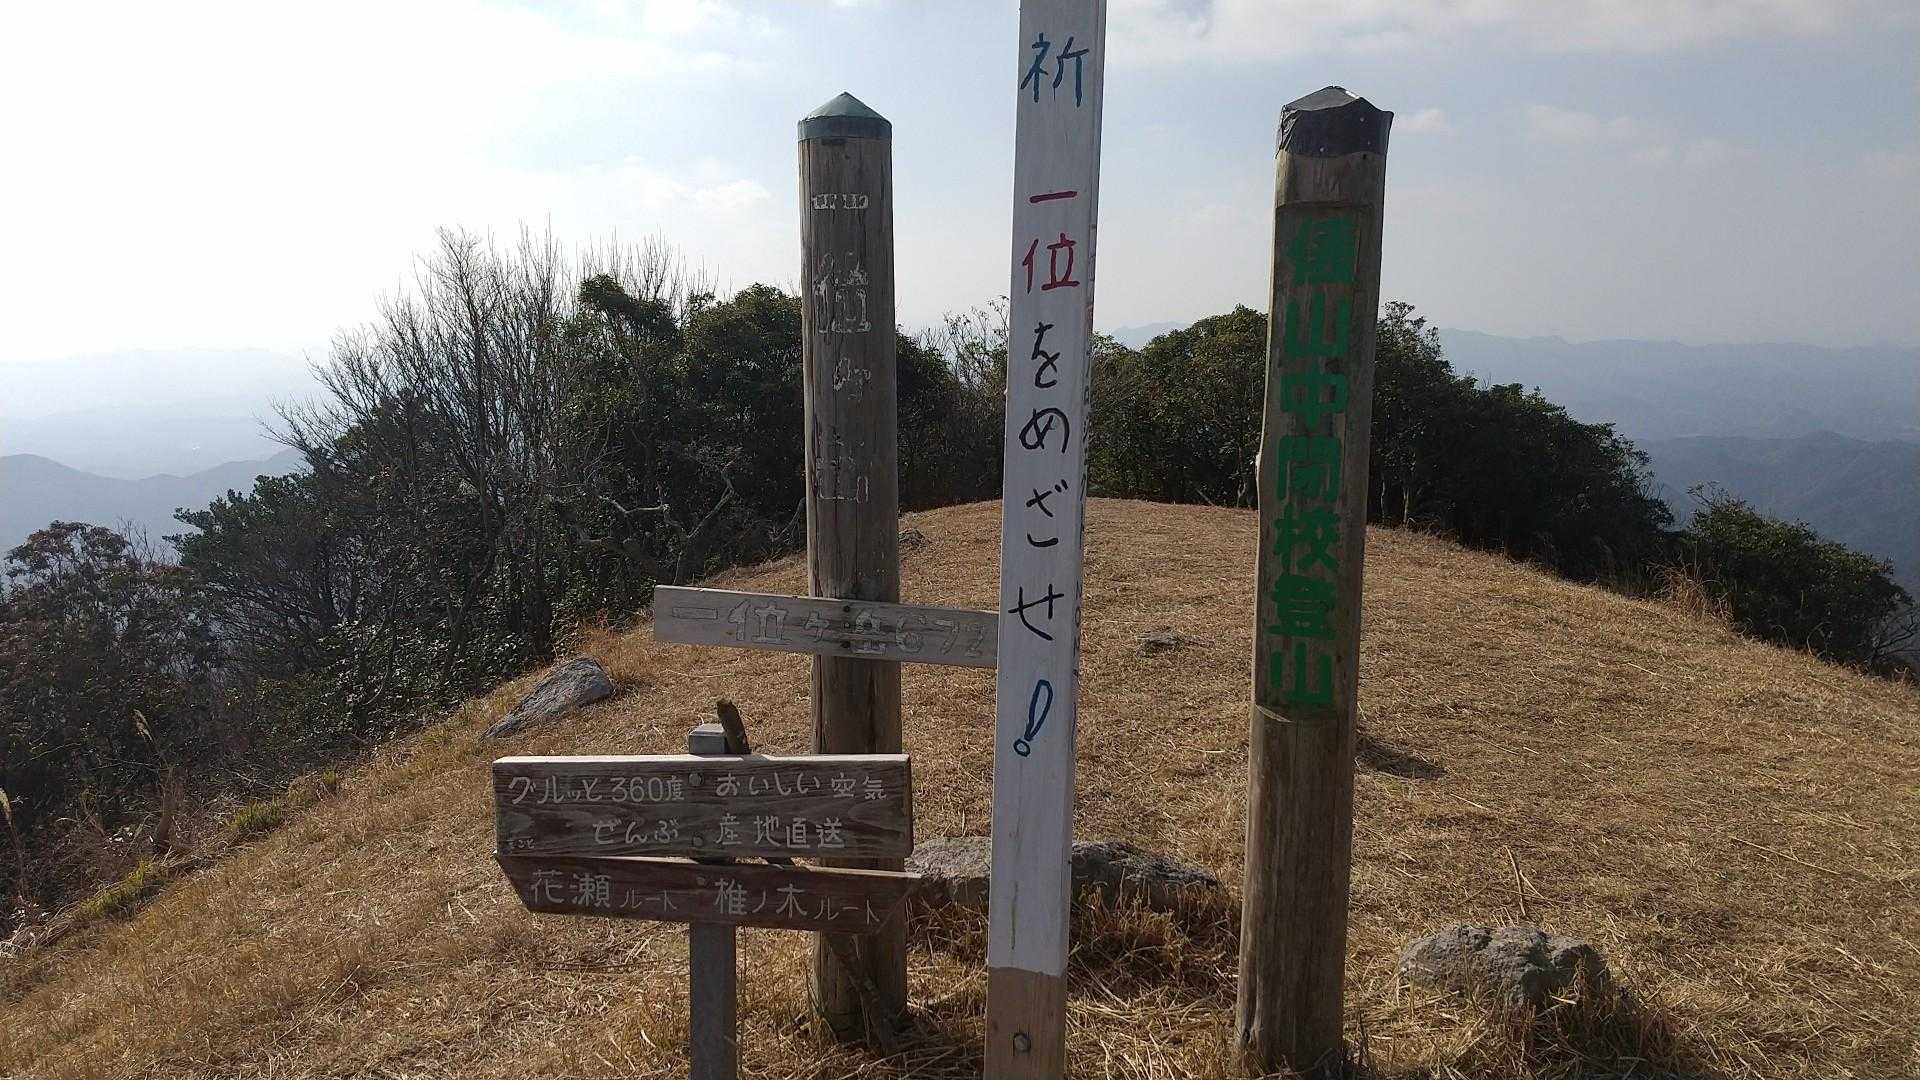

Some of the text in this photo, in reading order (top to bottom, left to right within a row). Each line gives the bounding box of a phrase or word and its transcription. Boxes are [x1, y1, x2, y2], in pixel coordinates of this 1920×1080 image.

[1019, 32, 1089, 107] 祈
[592, 812, 847, 849] ぜんぶ 産地直送
